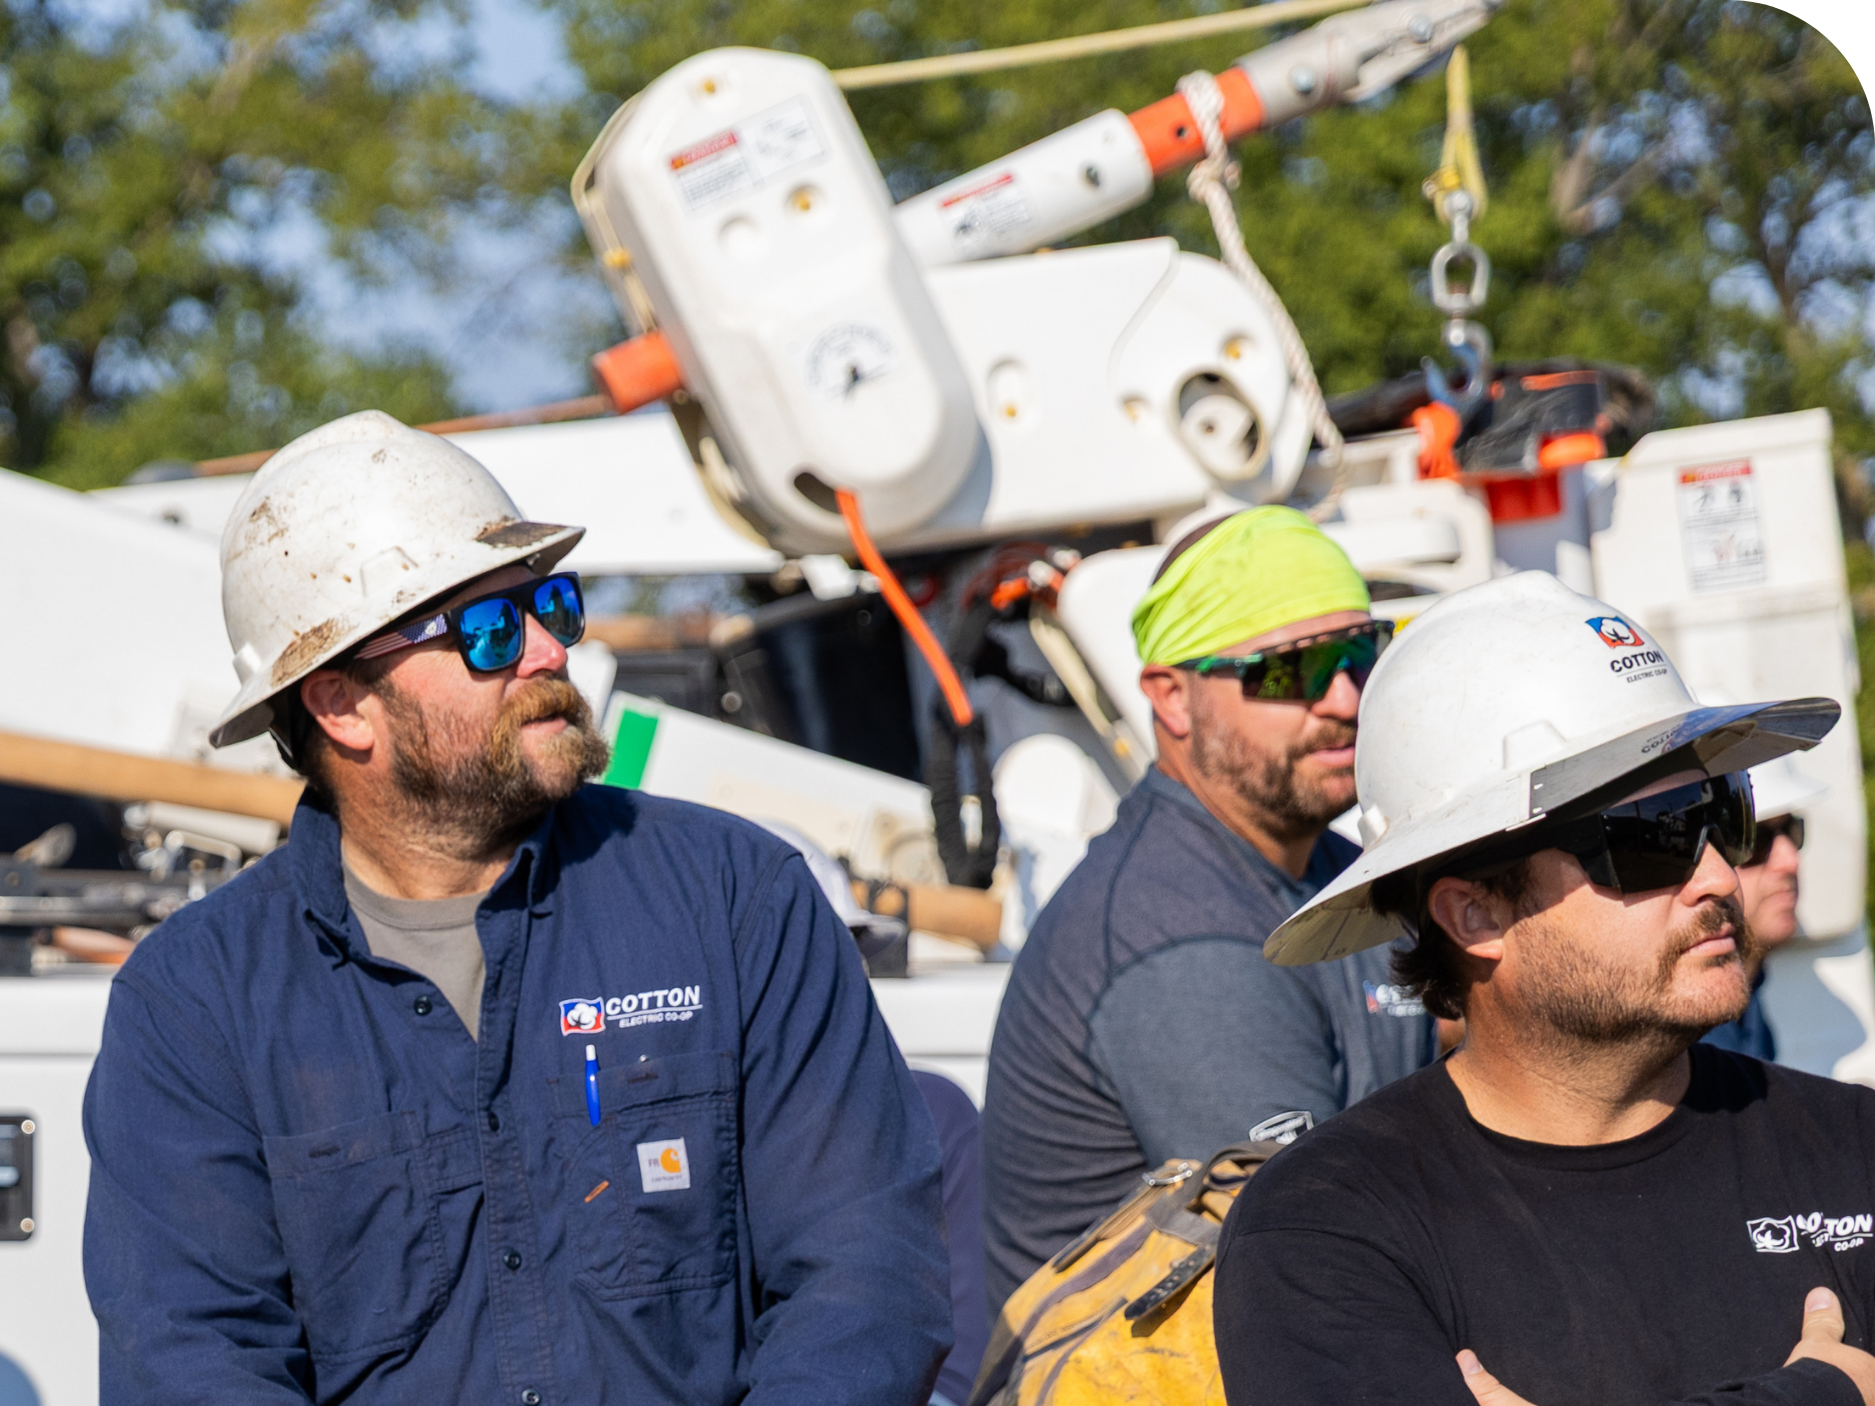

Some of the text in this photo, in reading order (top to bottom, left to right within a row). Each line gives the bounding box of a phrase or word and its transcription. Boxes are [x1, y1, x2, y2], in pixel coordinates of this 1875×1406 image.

[1610, 650, 1664, 673] COTTON
[1626, 670, 1654, 683] ELECTRIC
[606, 985, 700, 1015] COTTON
[619, 1010, 693, 1028] ELECTRIC CO-OP
